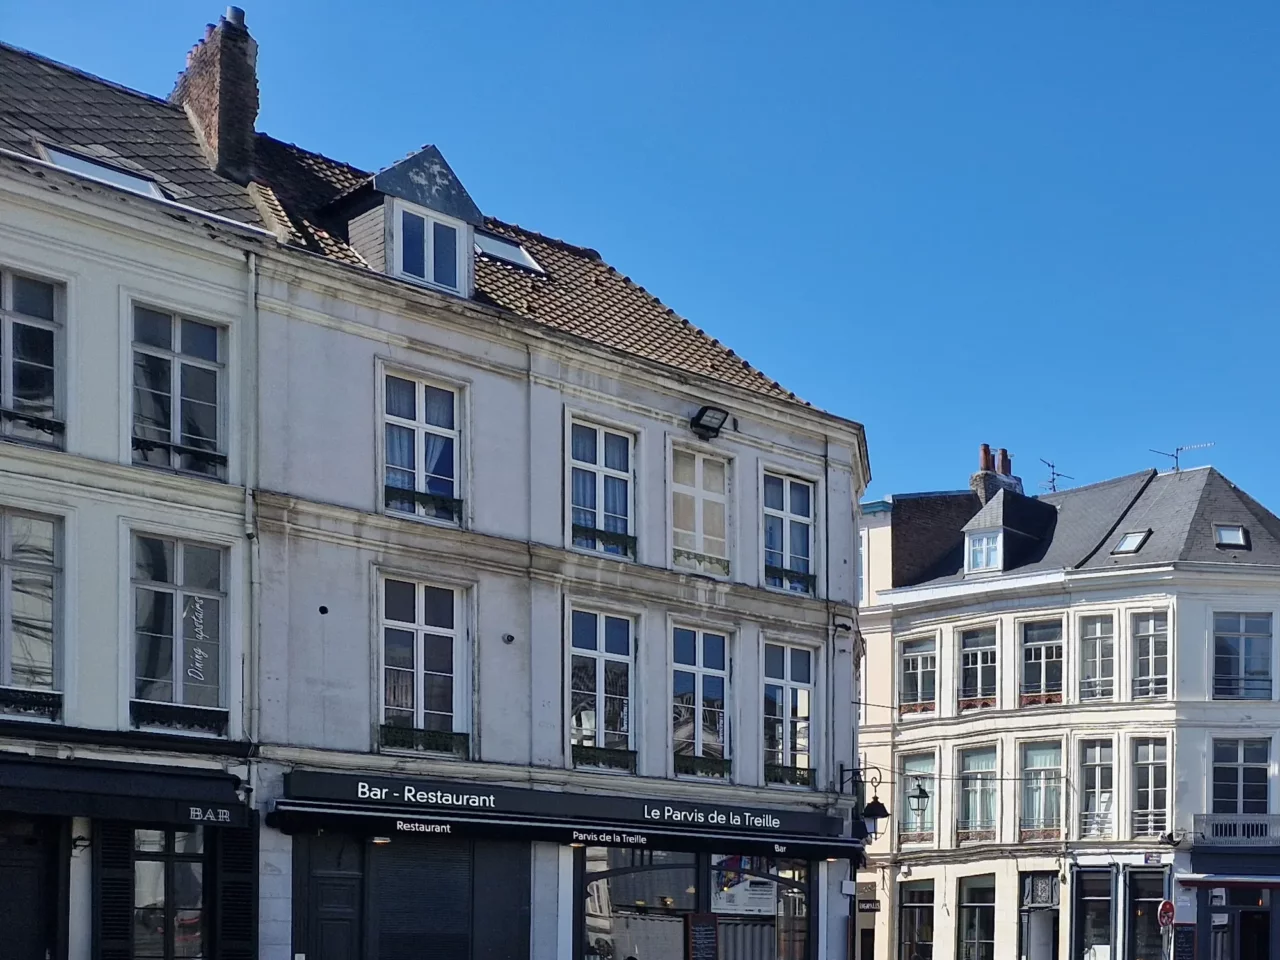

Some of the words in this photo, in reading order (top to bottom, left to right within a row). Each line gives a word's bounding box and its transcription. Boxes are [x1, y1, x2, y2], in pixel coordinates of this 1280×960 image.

[191, 597, 209, 640] upstairs
[187, 647, 208, 681] Dining
[357, 782, 389, 799] Bar
[404, 786, 495, 808] Restaurant
[189, 807, 231, 822] BAR
[644, 805, 661, 820] Le
[664, 806, 705, 823] Parvis
[708, 810, 727, 825] de
[729, 813, 742, 826] la
[744, 812, 781, 828] Treille
[396, 820, 451, 833] Restaurant
[572, 831, 598, 842] Parvis
[599, 833, 612, 843] de
[613, 833, 621, 843] la
[622, 834, 647, 844] Treille
[774, 843, 787, 853] Bar
